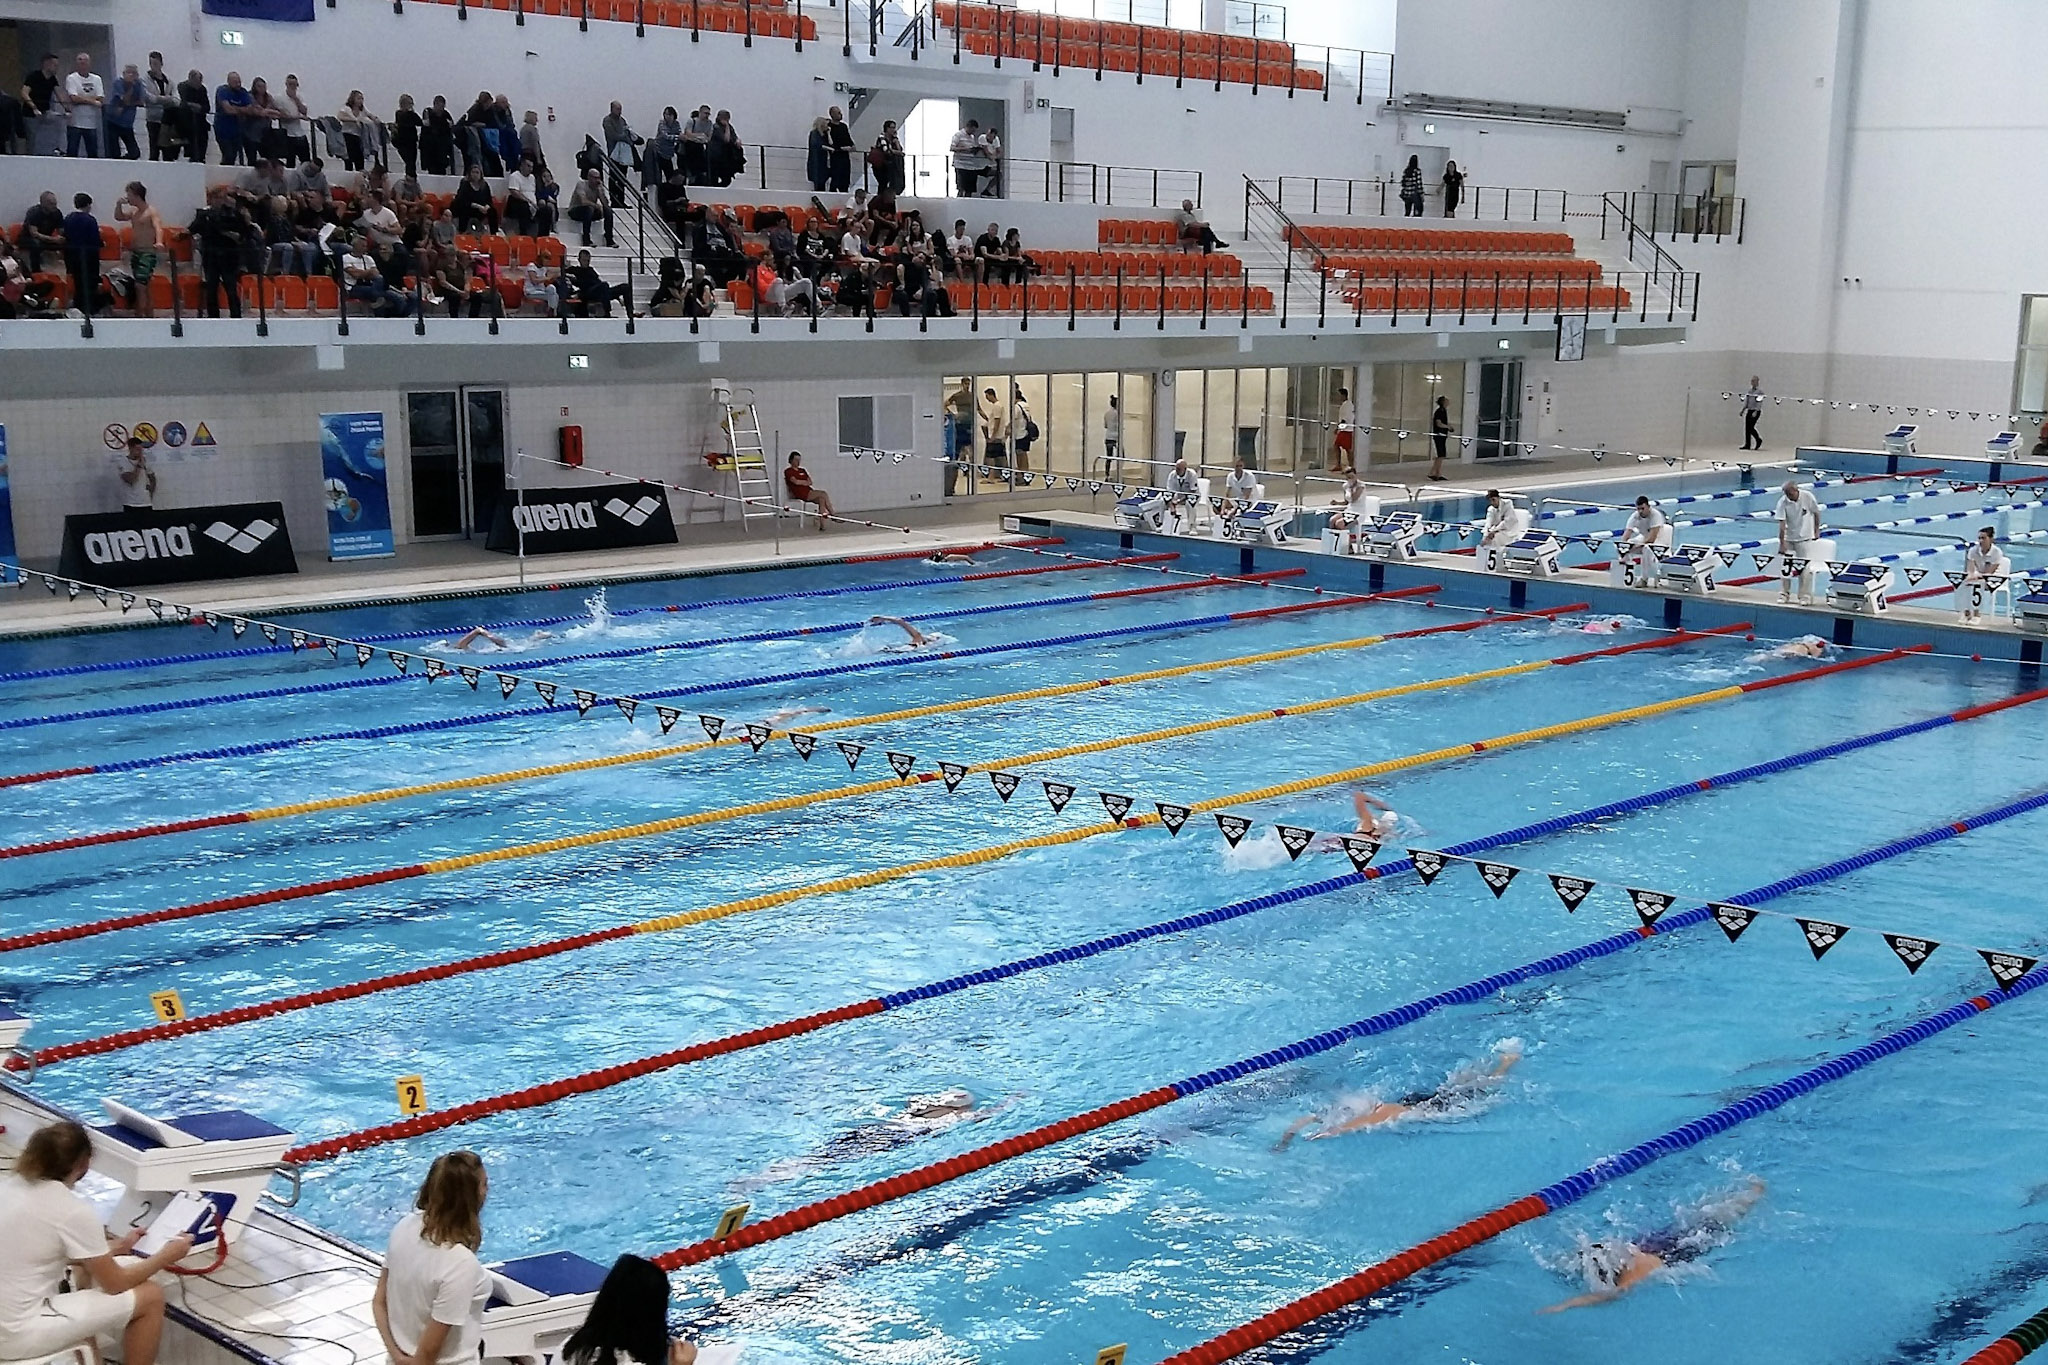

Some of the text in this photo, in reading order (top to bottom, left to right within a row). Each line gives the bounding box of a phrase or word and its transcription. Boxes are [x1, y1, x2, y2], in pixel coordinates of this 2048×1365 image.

[513, 502, 597, 533] arena
[1222, 518, 1232, 538] 5
[84, 526, 194, 564] arena
[1487, 549, 1497, 571] 5
[1780, 557, 1793, 577] 5
[1624, 564, 1634, 586] 5
[1971, 583, 1982, 607] 5
[1558, 878, 1585, 890] arena
[1637, 891, 1665, 905] arena
[1718, 906, 1748, 919] arena
[1807, 921, 1837, 936] arena
[1895, 937, 1927, 952] arena
[1991, 953, 2024, 968] arena
[161, 999, 176, 1017] 3
[406, 1085, 420, 1109] 2
[129, 1201, 152, 1228] 2
